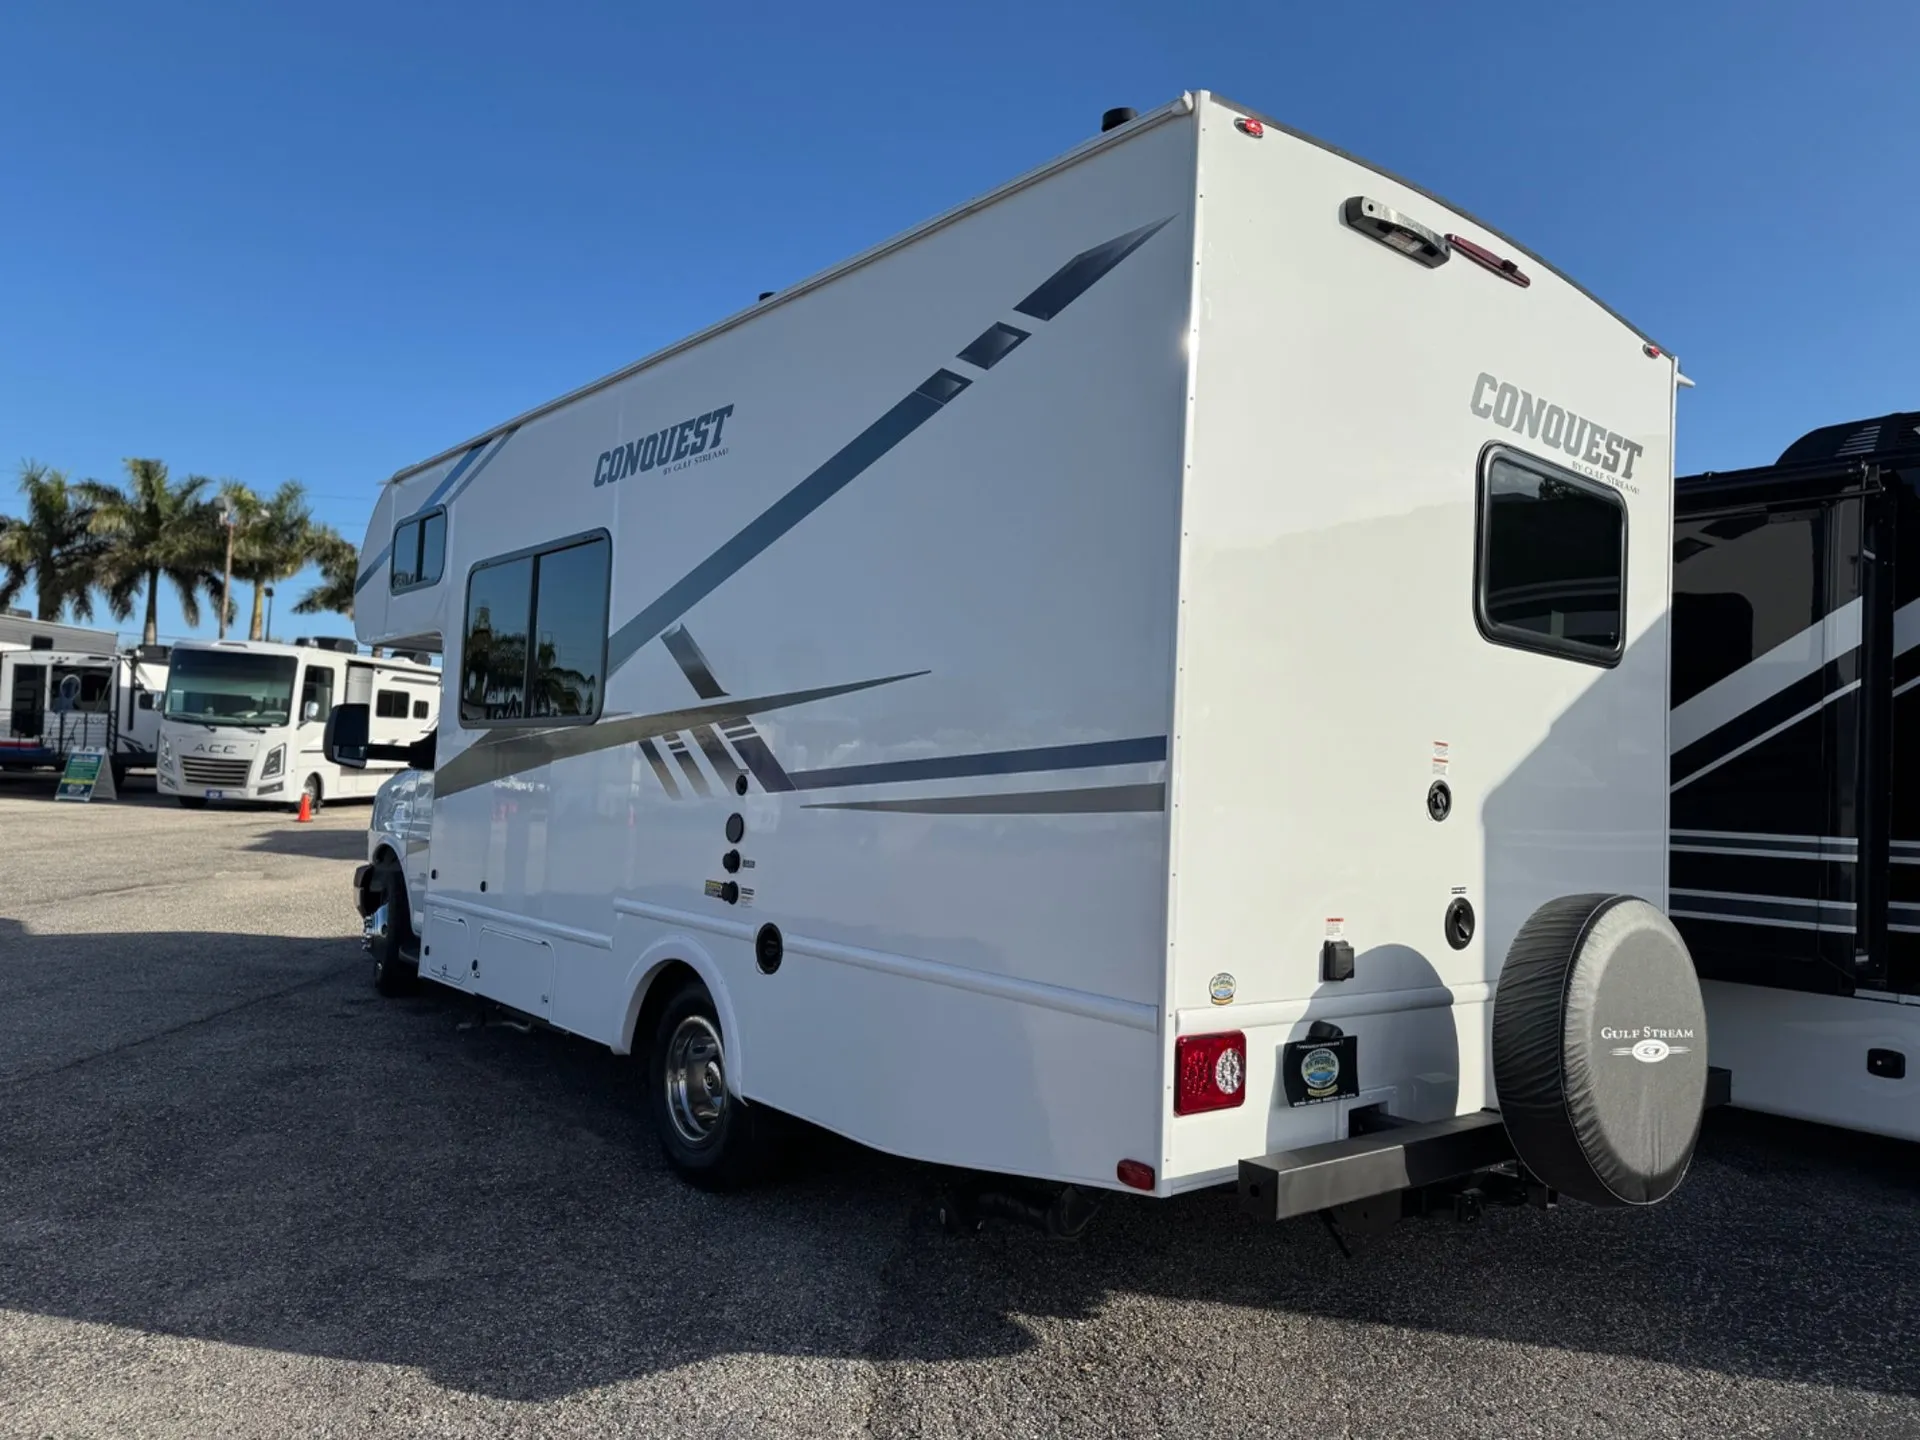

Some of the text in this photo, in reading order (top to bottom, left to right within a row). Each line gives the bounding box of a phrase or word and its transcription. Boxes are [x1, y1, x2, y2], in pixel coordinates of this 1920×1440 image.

[1470, 371, 1643, 480] CONQUEST
[593, 403, 735, 488] CONQUEST
[663, 467, 672, 476] BY
[673, 460, 692, 472] GULF
[1572, 460, 1583, 472] BY
[1585, 466, 1605, 481] GULF
[1600, 1026, 1694, 1039] GULF STREAM
